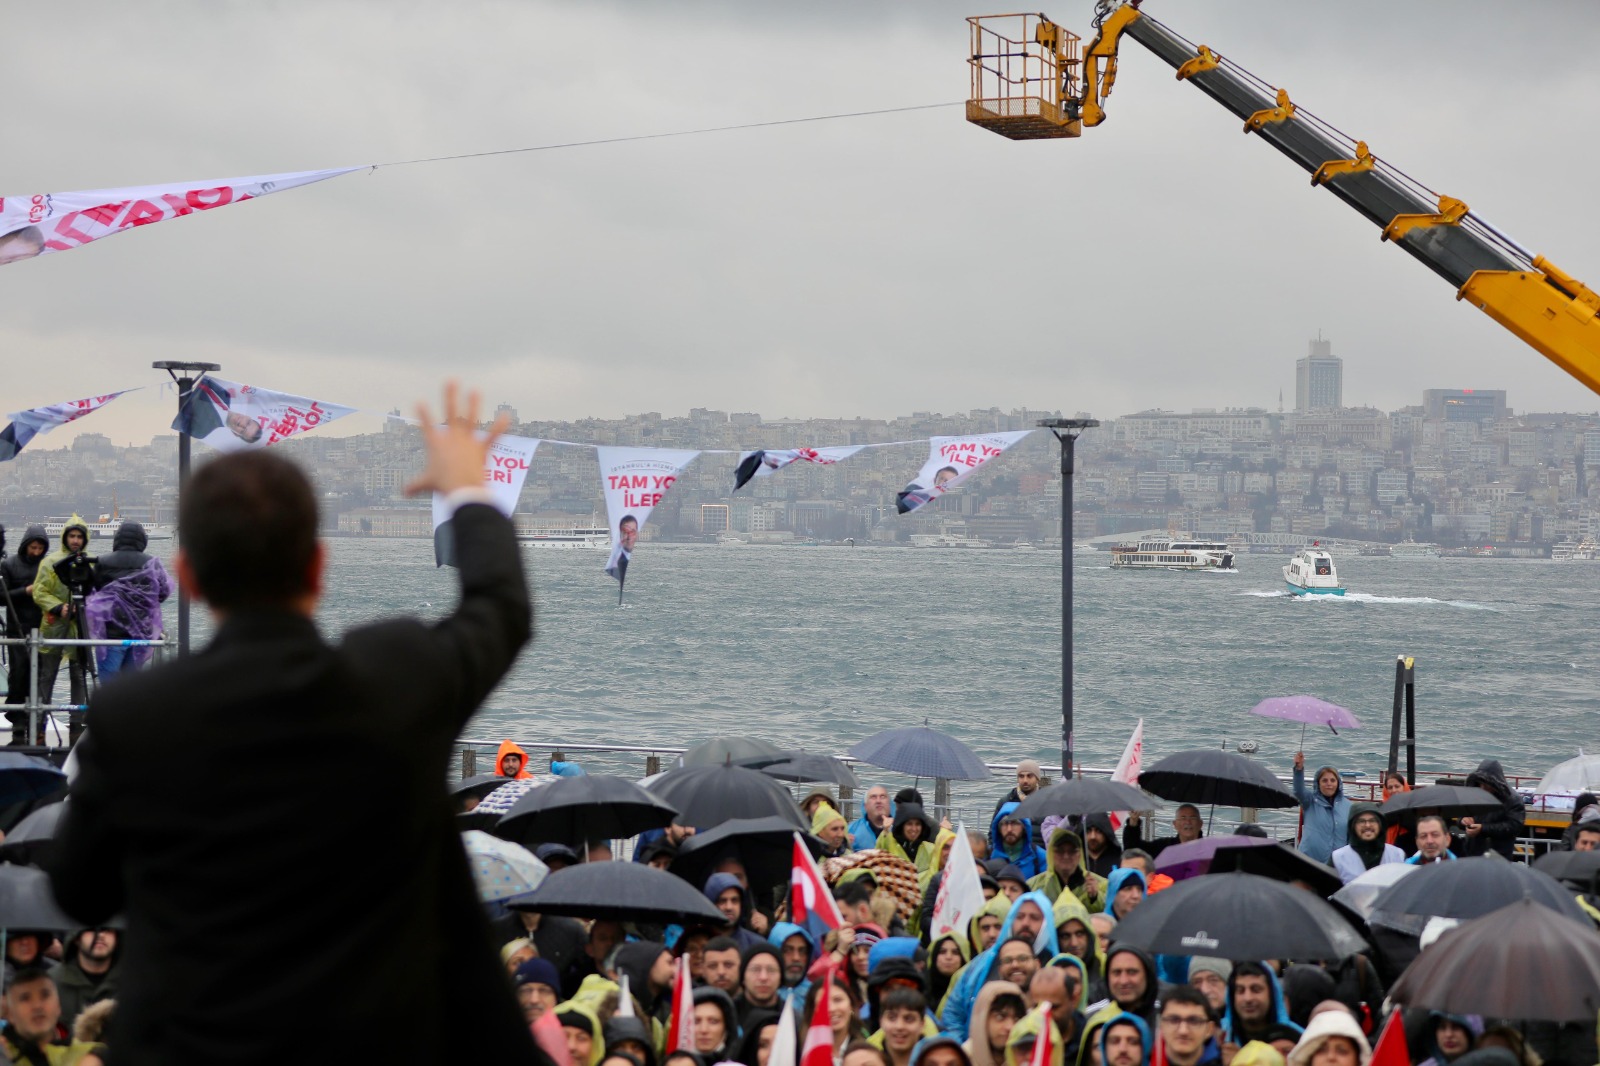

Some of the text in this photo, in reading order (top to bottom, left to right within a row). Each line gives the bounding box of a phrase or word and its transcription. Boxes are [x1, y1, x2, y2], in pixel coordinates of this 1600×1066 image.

[940, 443, 1002, 457] TAM YO
[492, 454, 530, 470] YOL
[949, 451, 985, 467] İLE
[484, 468, 512, 484] ERİ
[608, 475, 677, 490] TAM YO
[624, 489, 663, 508] İLER
